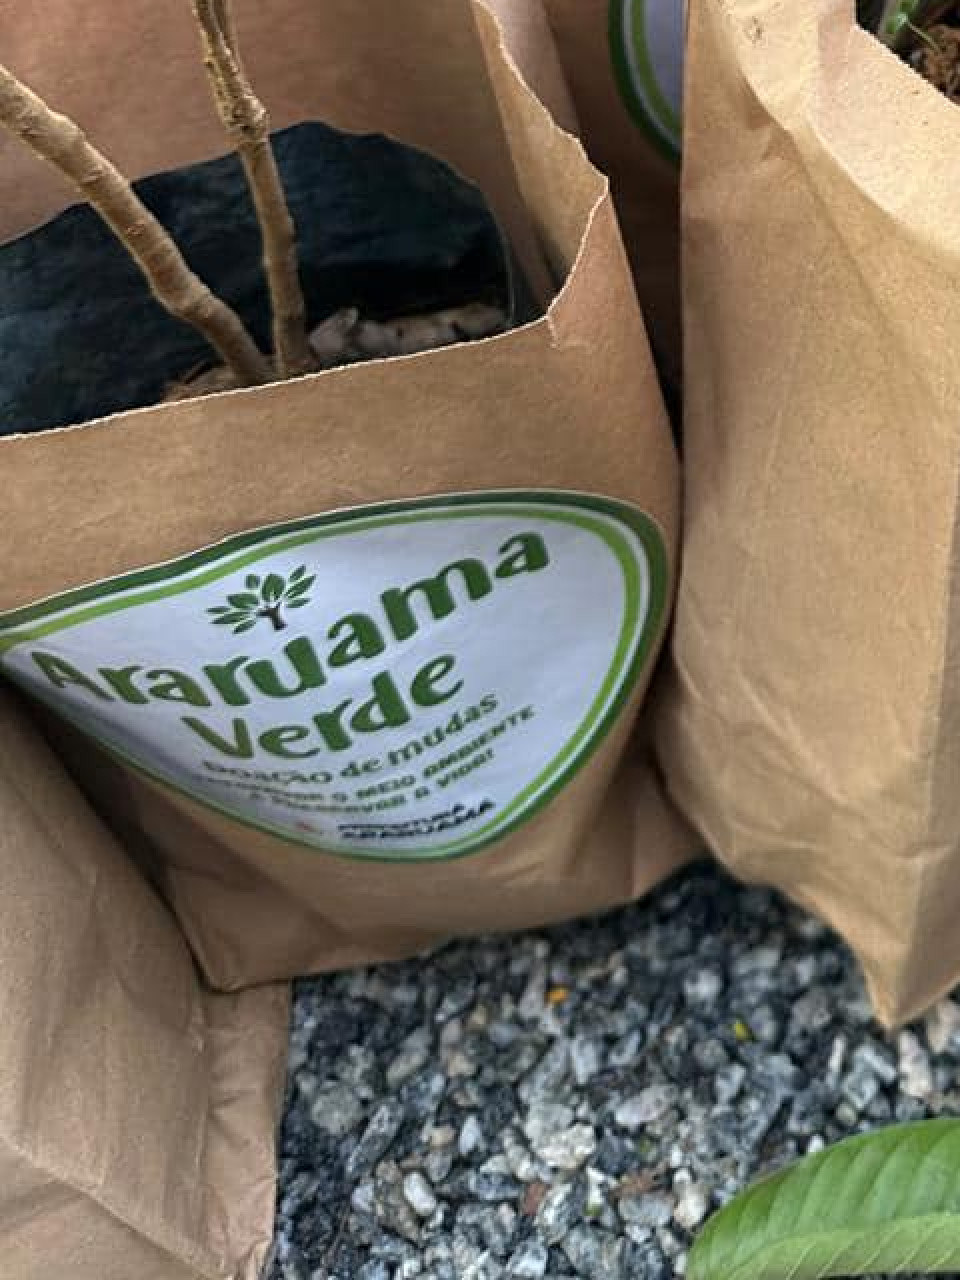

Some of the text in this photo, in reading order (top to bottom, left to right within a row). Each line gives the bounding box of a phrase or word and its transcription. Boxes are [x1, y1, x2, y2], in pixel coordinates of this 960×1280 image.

[29, 530, 551, 707] Araruama
[182, 654, 465, 760] Verde
[387, 693, 499, 767] mudas
